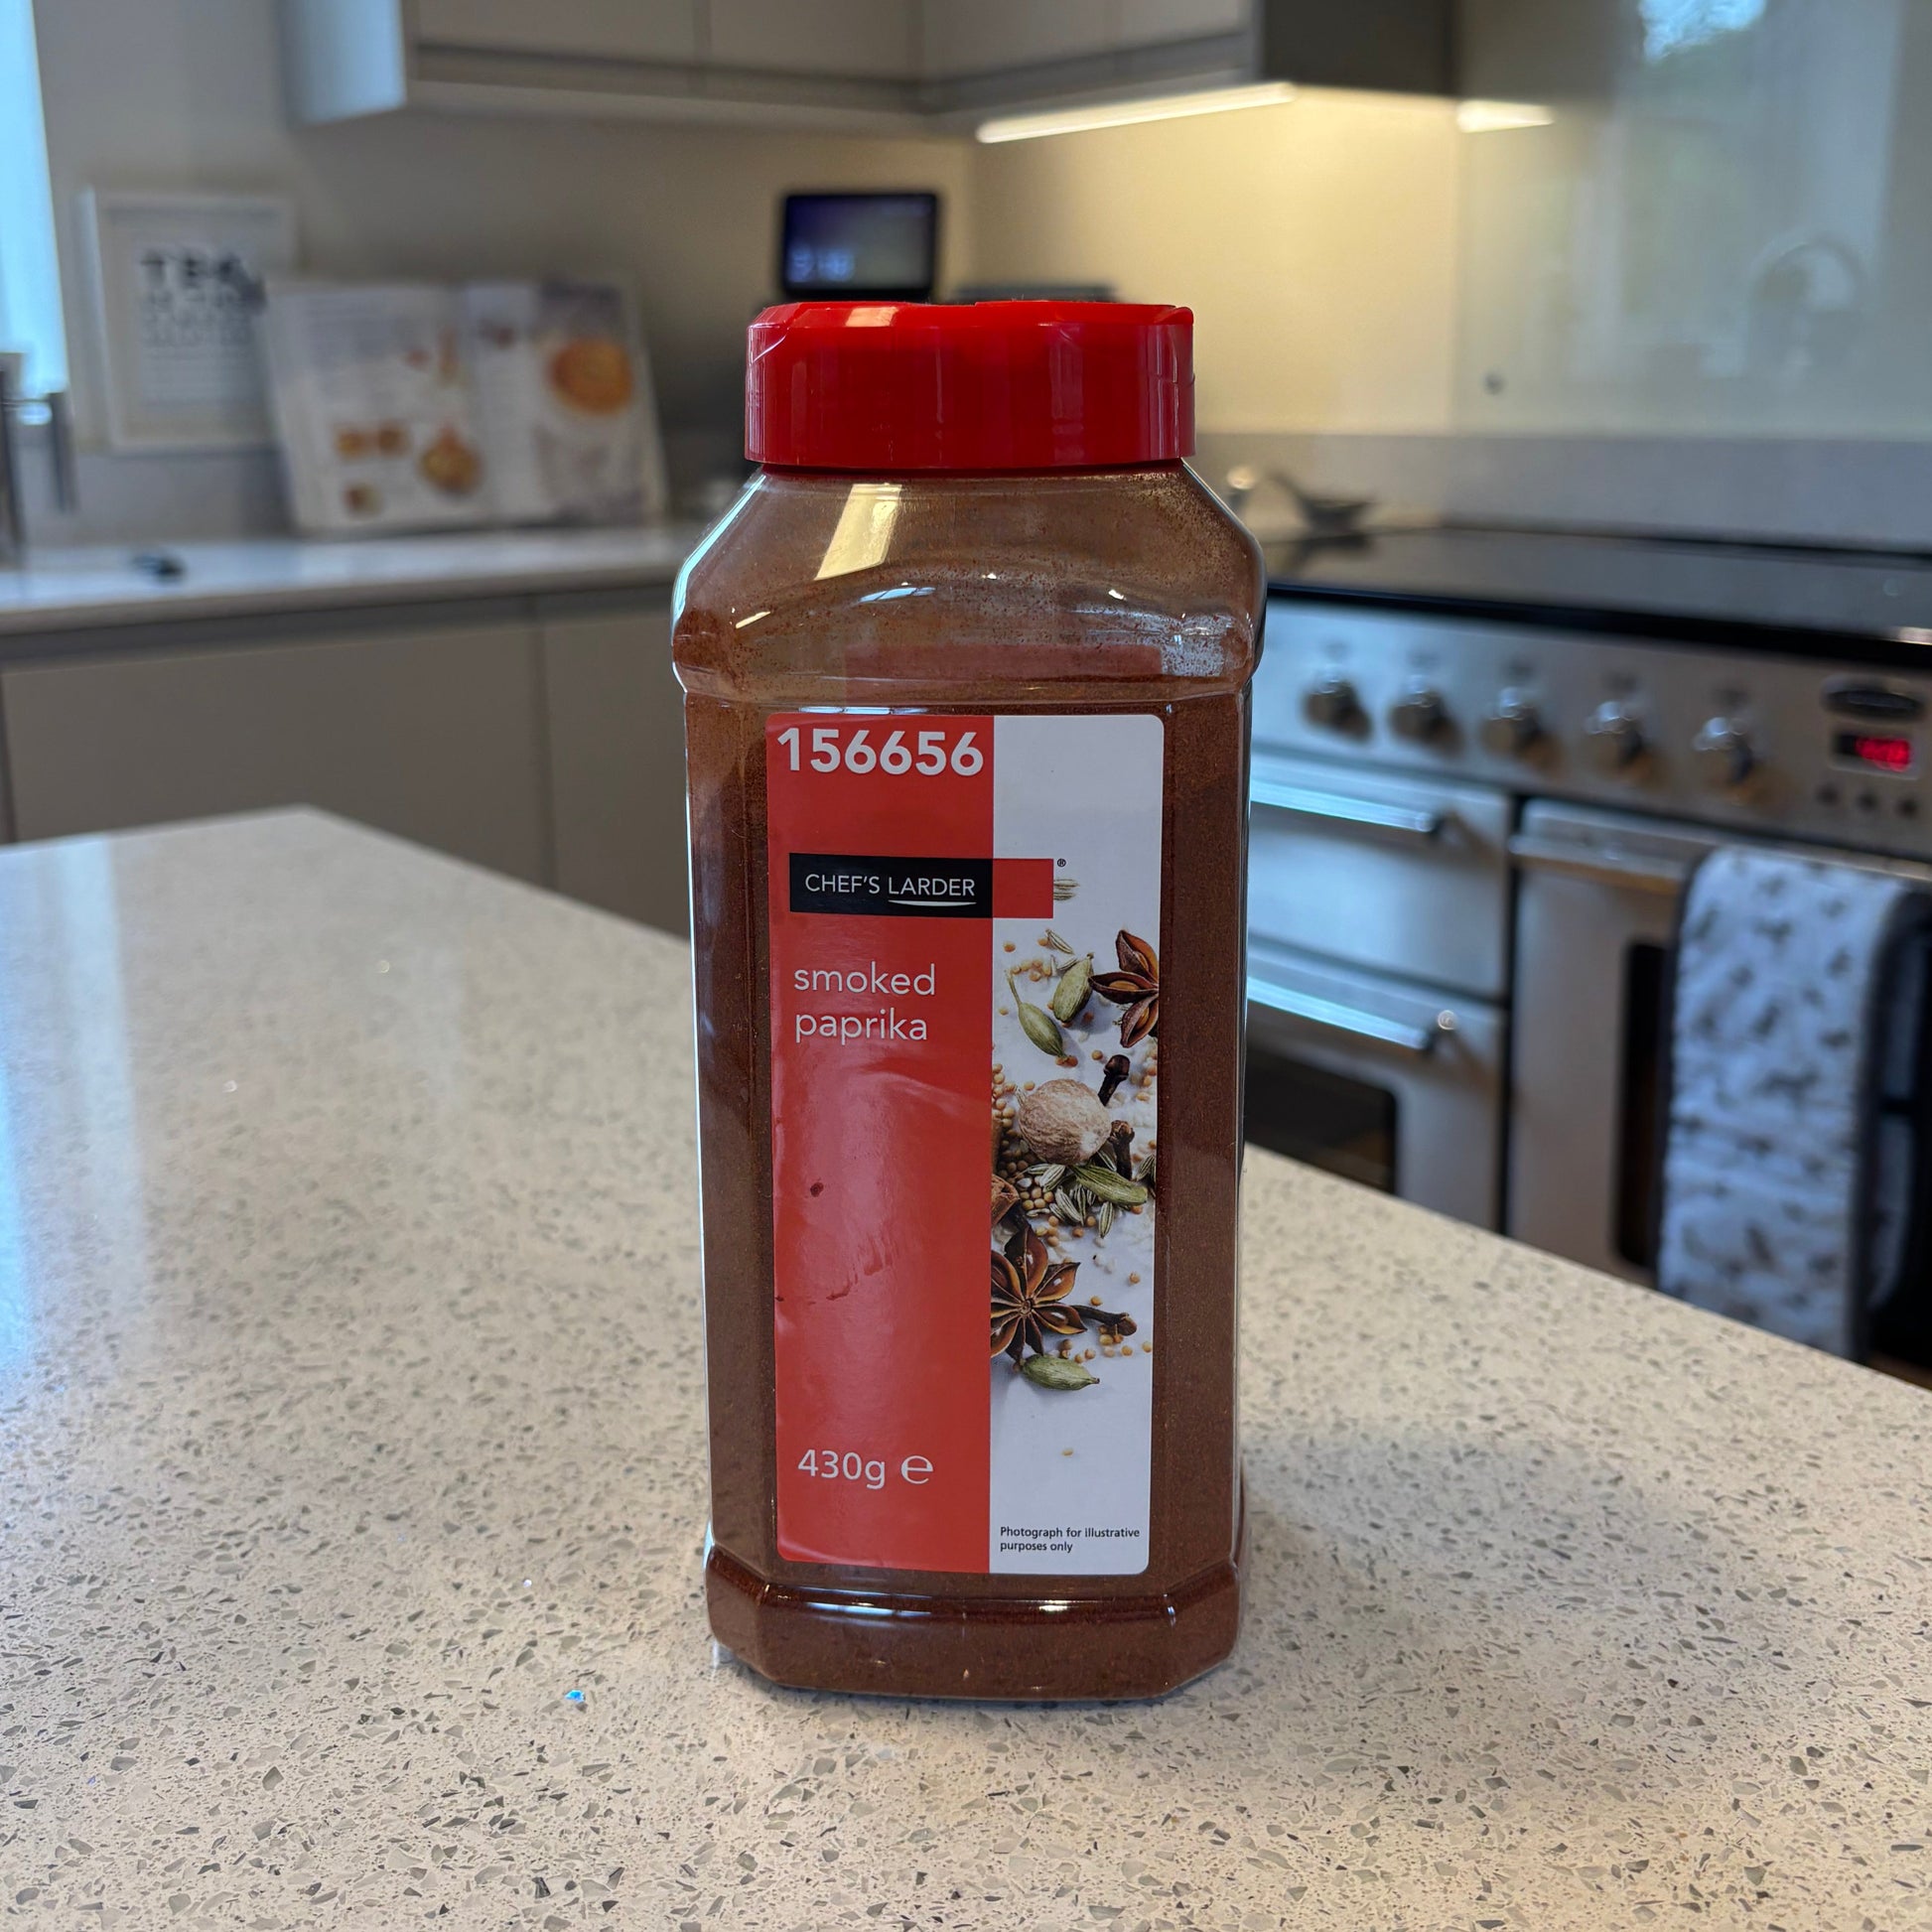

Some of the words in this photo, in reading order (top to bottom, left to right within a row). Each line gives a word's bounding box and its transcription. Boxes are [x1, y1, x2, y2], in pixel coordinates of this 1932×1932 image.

[776, 728, 984, 777] 156656
[805, 874, 880, 895] CHEF'S
[888, 877, 975, 897] LARDER
[794, 961, 936, 996] smoked
[795, 1007, 928, 1045] paprika
[797, 1449, 886, 1489] 430g
[1000, 1526, 1062, 1539] Photograph
[1066, 1526, 1082, 1537] for
[1084, 1527, 1140, 1538] illustrative
[1000, 1542, 1047, 1552] purposes
[1050, 1541, 1073, 1553] only
